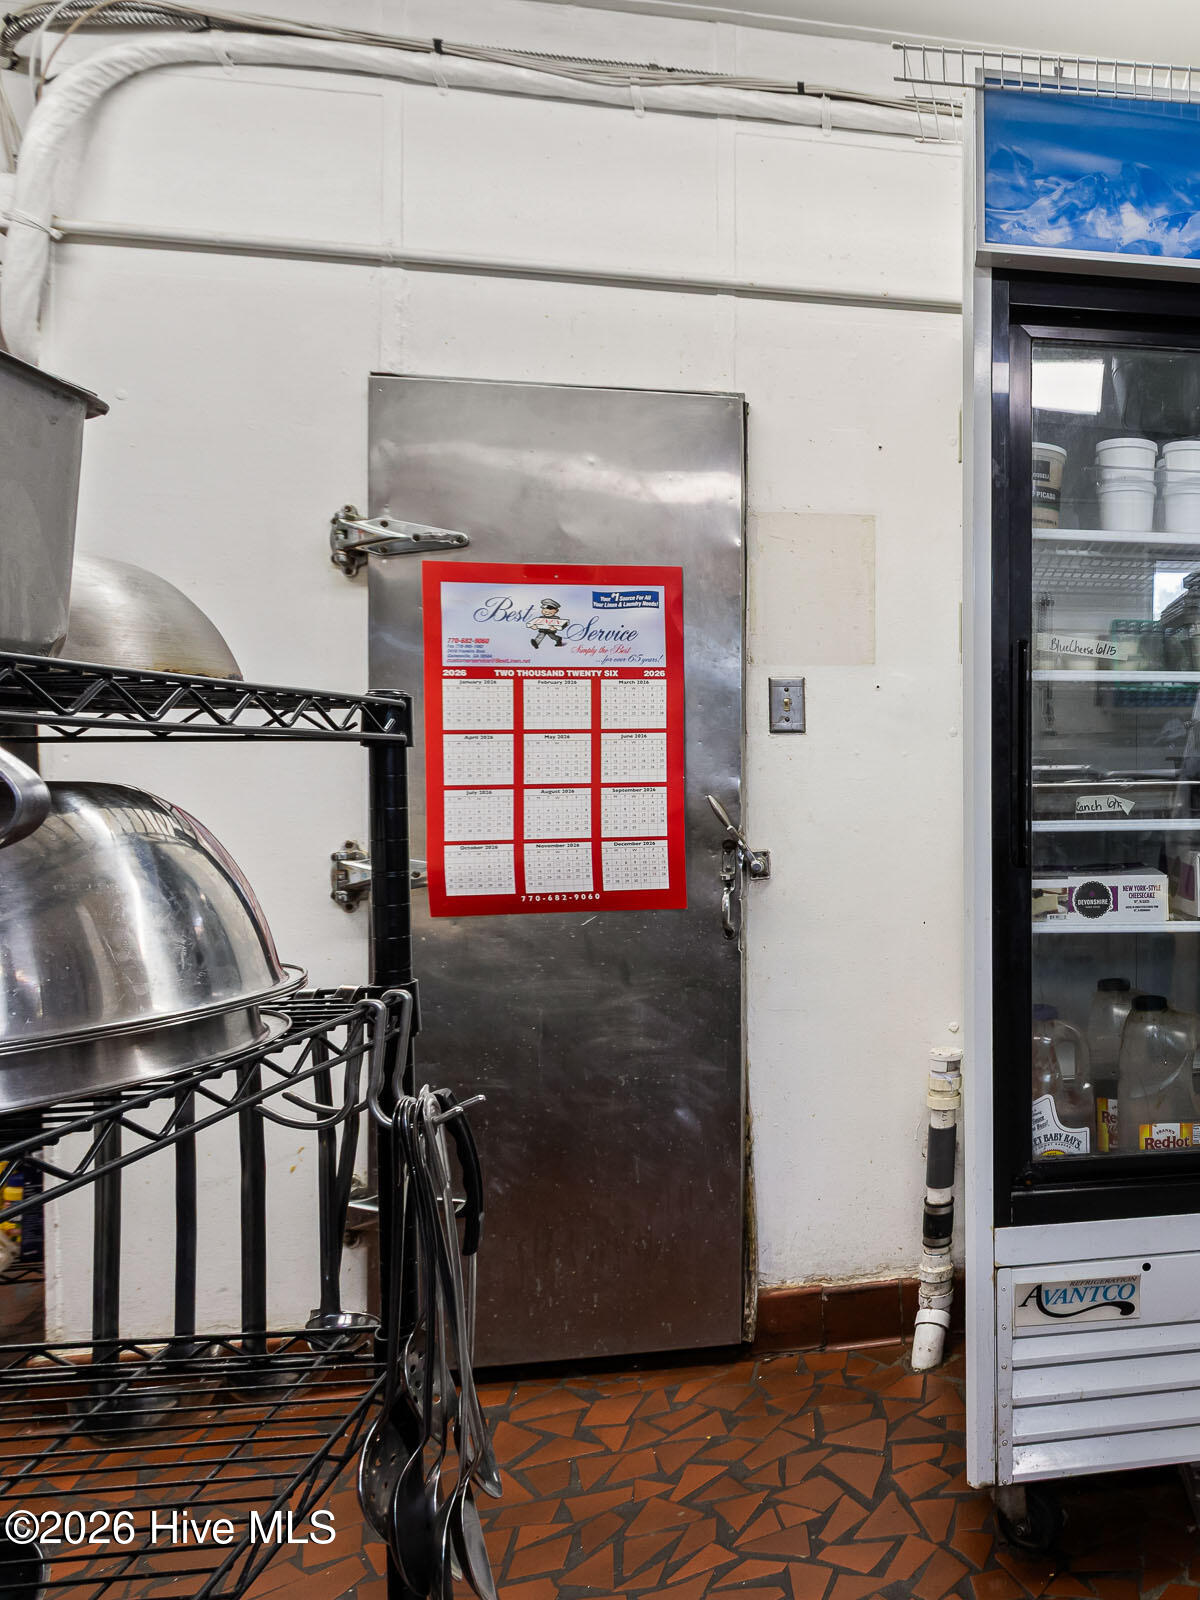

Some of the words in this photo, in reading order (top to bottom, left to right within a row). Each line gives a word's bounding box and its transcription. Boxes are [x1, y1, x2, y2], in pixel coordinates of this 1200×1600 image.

[611, 593, 619, 601] #1
[473, 596, 534, 622] Best
[565, 616, 638, 641] Service
[610, 644, 631, 654] Best
[521, 894, 600, 902] 770-682-9060
[1043, 1133, 1064, 1142] BABY
[1064, 1133, 1082, 1149] RAY'S
[1144, 1136, 1190, 1150] RedHot
[1070, 1276, 1137, 1286] REFRIGERATION
[1018, 1283, 1136, 1313] AVANTCO
